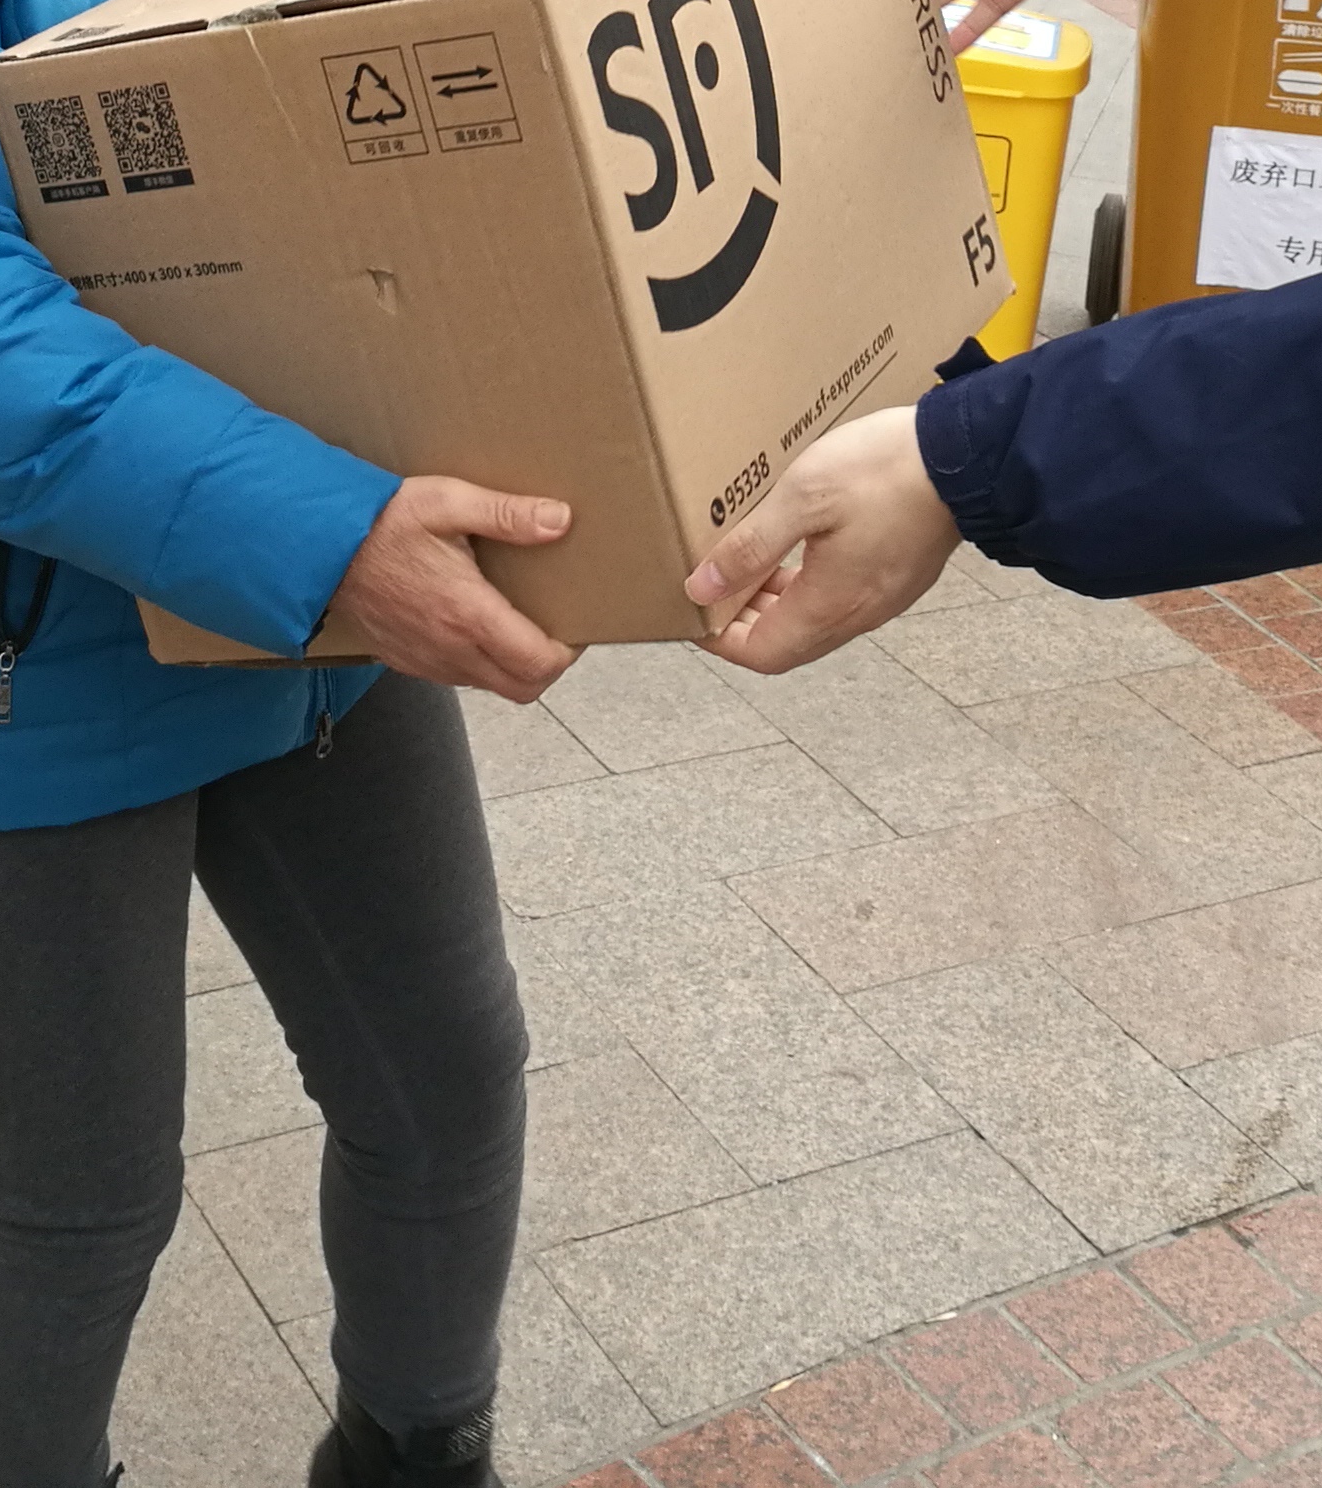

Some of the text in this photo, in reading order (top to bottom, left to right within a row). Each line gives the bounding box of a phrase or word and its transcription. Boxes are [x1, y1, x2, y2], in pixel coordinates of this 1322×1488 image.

[364, 139, 407, 155] 可回收
[453, 126, 504, 147] 重复使用
[963, 213, 997, 288] F5
[158, 265, 182, 282] 300
[194, 260, 244, 276] 300mm
[722, 322, 896, 518] 95338 www.sf-express.com
